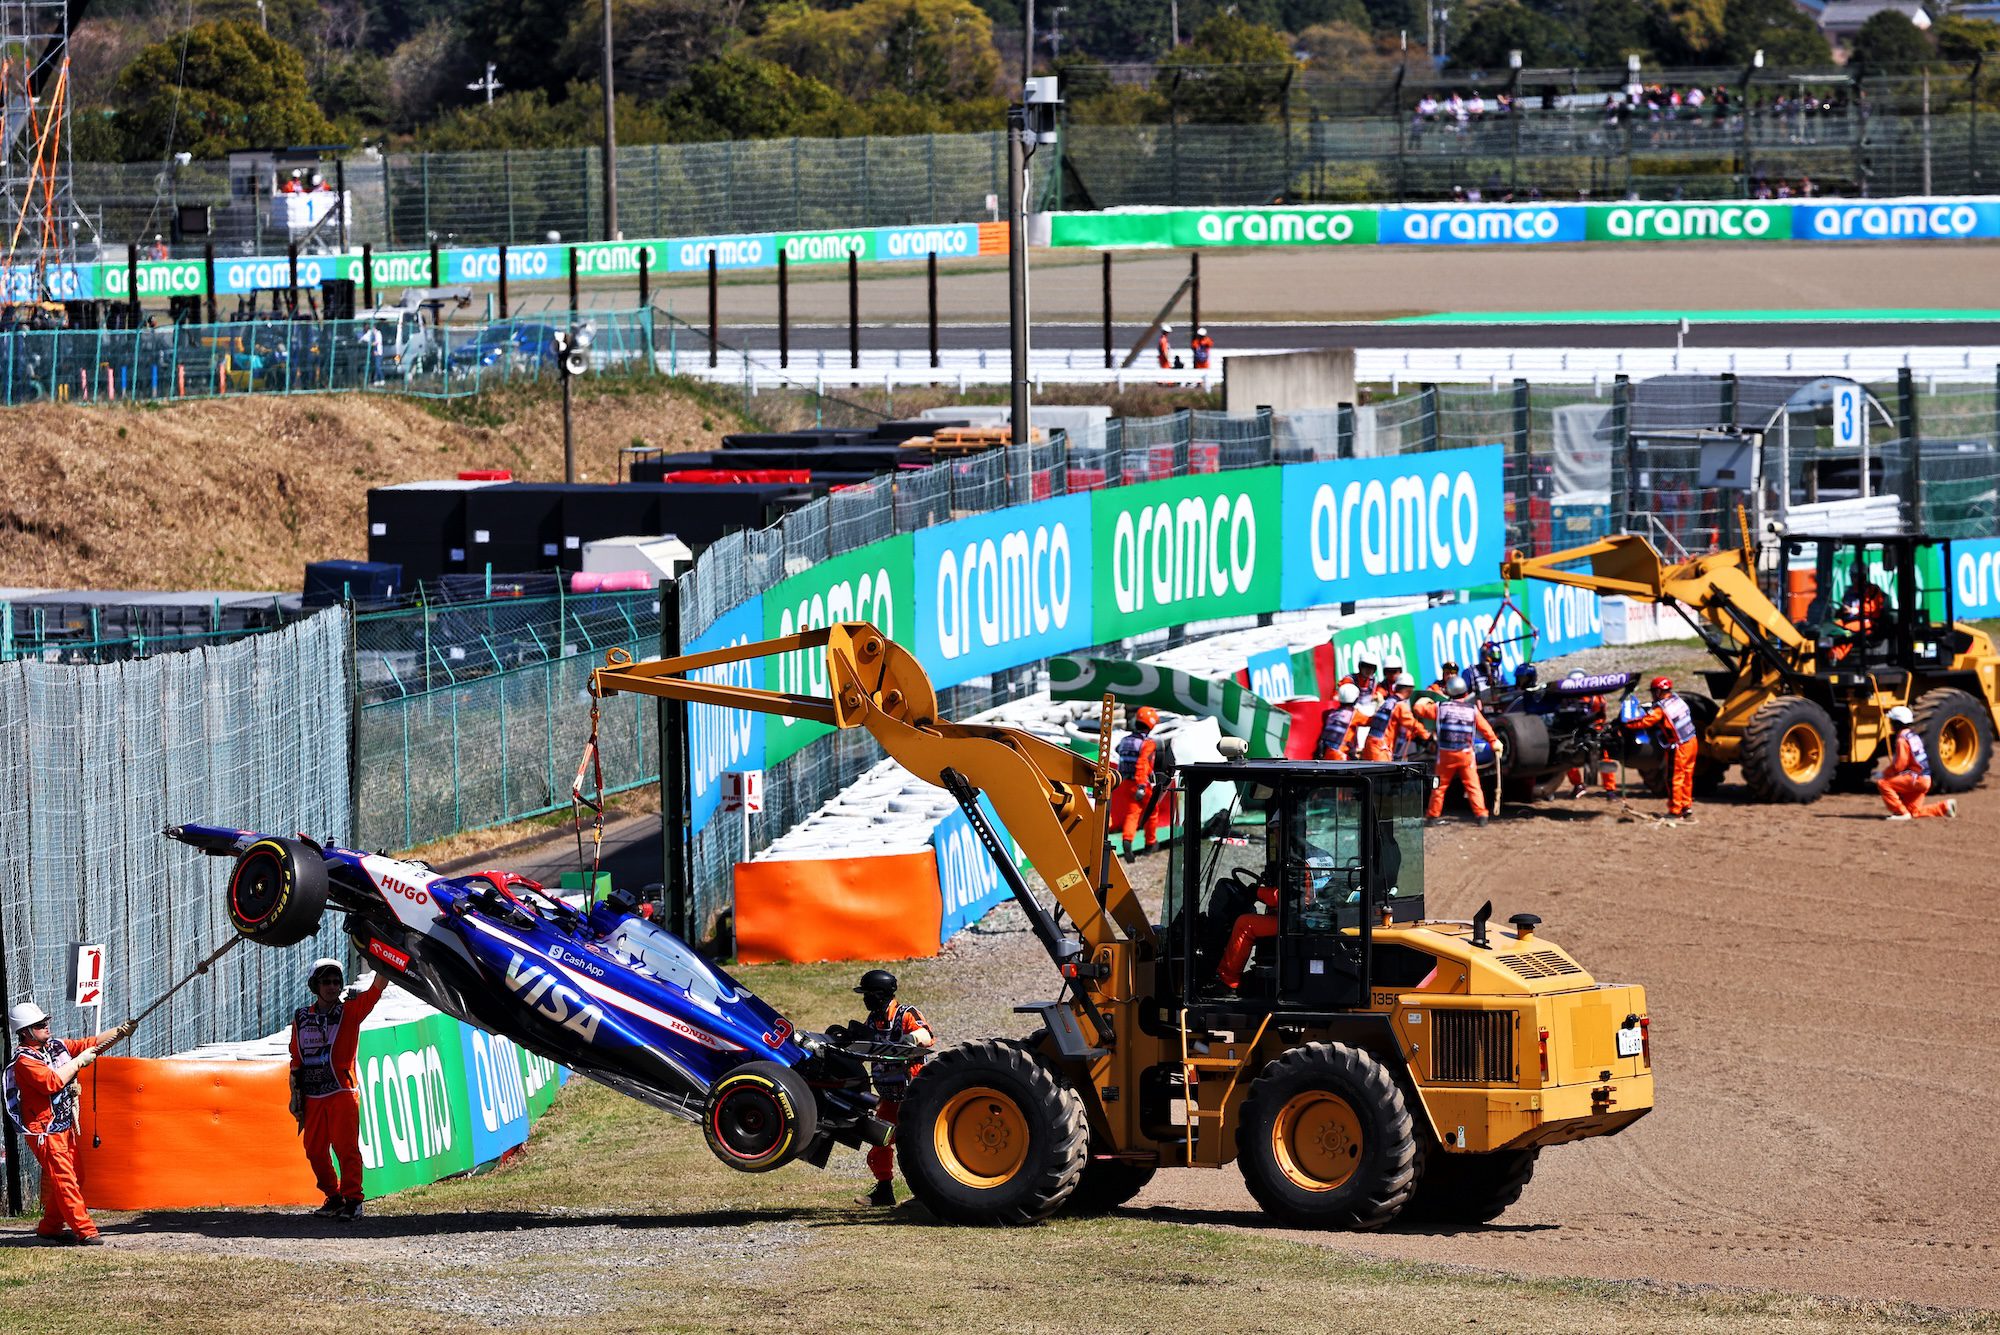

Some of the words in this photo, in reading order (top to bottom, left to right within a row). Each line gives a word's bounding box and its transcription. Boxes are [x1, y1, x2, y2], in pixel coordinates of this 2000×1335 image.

[306, 200, 313, 222] 1
[1606, 208, 1770, 236] aramco
[1814, 206, 1977, 235] aramco
[1197, 214, 1353, 242] aramco
[1403, 211, 1559, 240] aramco
[785, 233, 866, 260] aramco
[889, 229, 967, 255] aramco
[1841, 391, 1854, 441] 3
[1310, 470, 1480, 582] aramco
[1112, 493, 1257, 615] aramco
[937, 522, 1071, 660] aramco
[1575, 672, 1627, 690] kraken
[381, 874, 428, 906] HUGO
[382, 950, 406, 968] ORLEN
[563, 952, 585, 969] Cash
[584, 962, 605, 977] App
[79, 981, 100, 989] FIRE
[504, 948, 604, 1044] VISA
[670, 1020, 717, 1046] HONDA
[761, 1017, 794, 1049] 3
